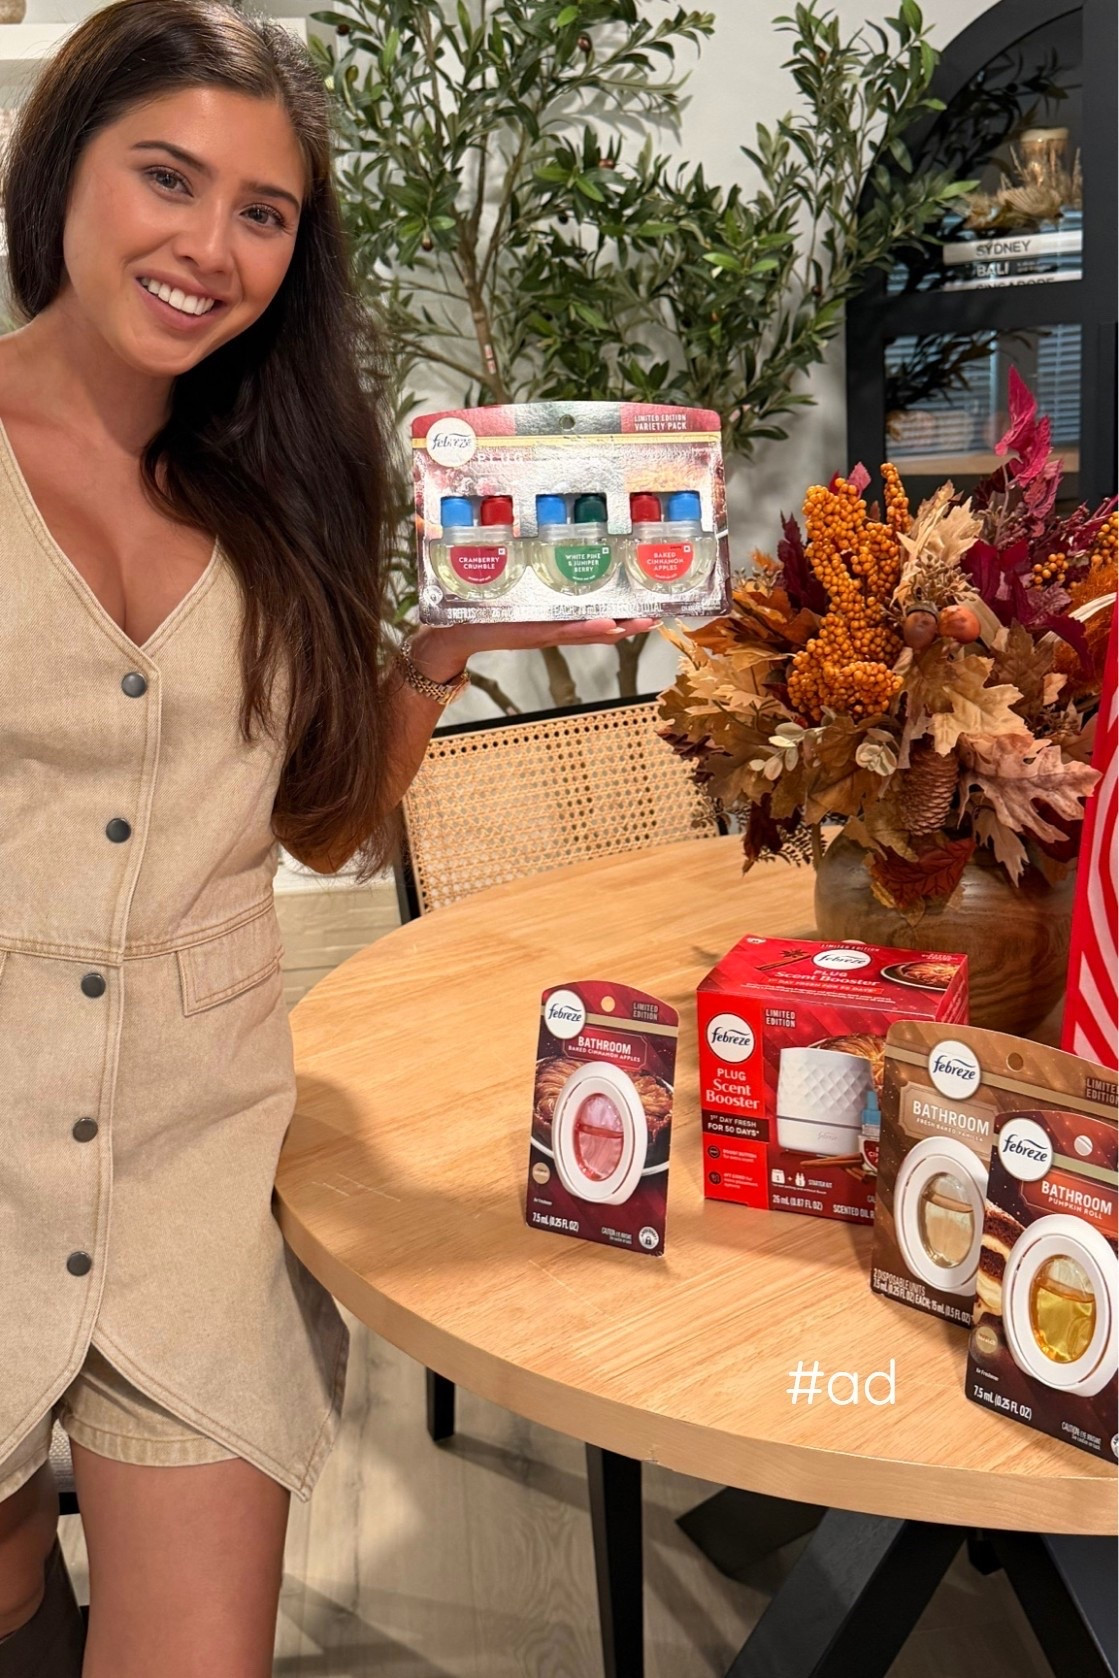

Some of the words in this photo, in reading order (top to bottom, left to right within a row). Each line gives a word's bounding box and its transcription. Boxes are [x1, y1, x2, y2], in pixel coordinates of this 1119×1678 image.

[976, 240, 1031, 257] SYDNEY
[976, 261, 1010, 277] BALI
[634, 414, 660, 422] LIMITED
[661, 413, 687, 422] EDITION
[634, 422, 666, 431] VARIETY
[667, 422, 688, 431] PACK
[458, 556, 500, 564] CRANBERRY
[818, 954, 866, 965] febreze
[775, 971, 816, 980] Scent
[819, 975, 880, 986] Booster
[548, 1003, 582, 1021] febreze
[633, 1002, 659, 1013] LIMITED
[633, 1010, 658, 1020] EDITION
[765, 1009, 796, 1019] LIMITED
[766, 1017, 796, 1028] EDITION
[711, 1026, 751, 1046] febreze
[578, 1036, 631, 1055] BATHROOM
[568, 1045, 587, 1053] BAKED
[619, 1054, 641, 1062] APPLES
[717, 1067, 747, 1081] PLUG
[933, 1055, 976, 1080] febreze
[713, 1078, 751, 1096] Scent
[705, 1089, 760, 1109] Booster
[719, 1116, 733, 1124] DAY
[734, 1118, 757, 1128] FRESH
[913, 1100, 990, 1136] BATHROOM
[916, 1118, 935, 1128] FRESH
[707, 1122, 724, 1131] FOR
[1002, 1133, 1048, 1163] febreze
[1041, 1180, 1112, 1216] BATHROOM
[833, 1204, 859, 1216] SCENTED
[1048, 1197, 1083, 1213] PUMPKIN
[1084, 1207, 1103, 1220] ROLL
[973, 1385, 984, 1398] 7.5
[983, 1388, 994, 1404] mL
[994, 1393, 1010, 1411] (0.25
[1011, 1402, 1019, 1415] FL
[1019, 1405, 1033, 1421] OZ)
